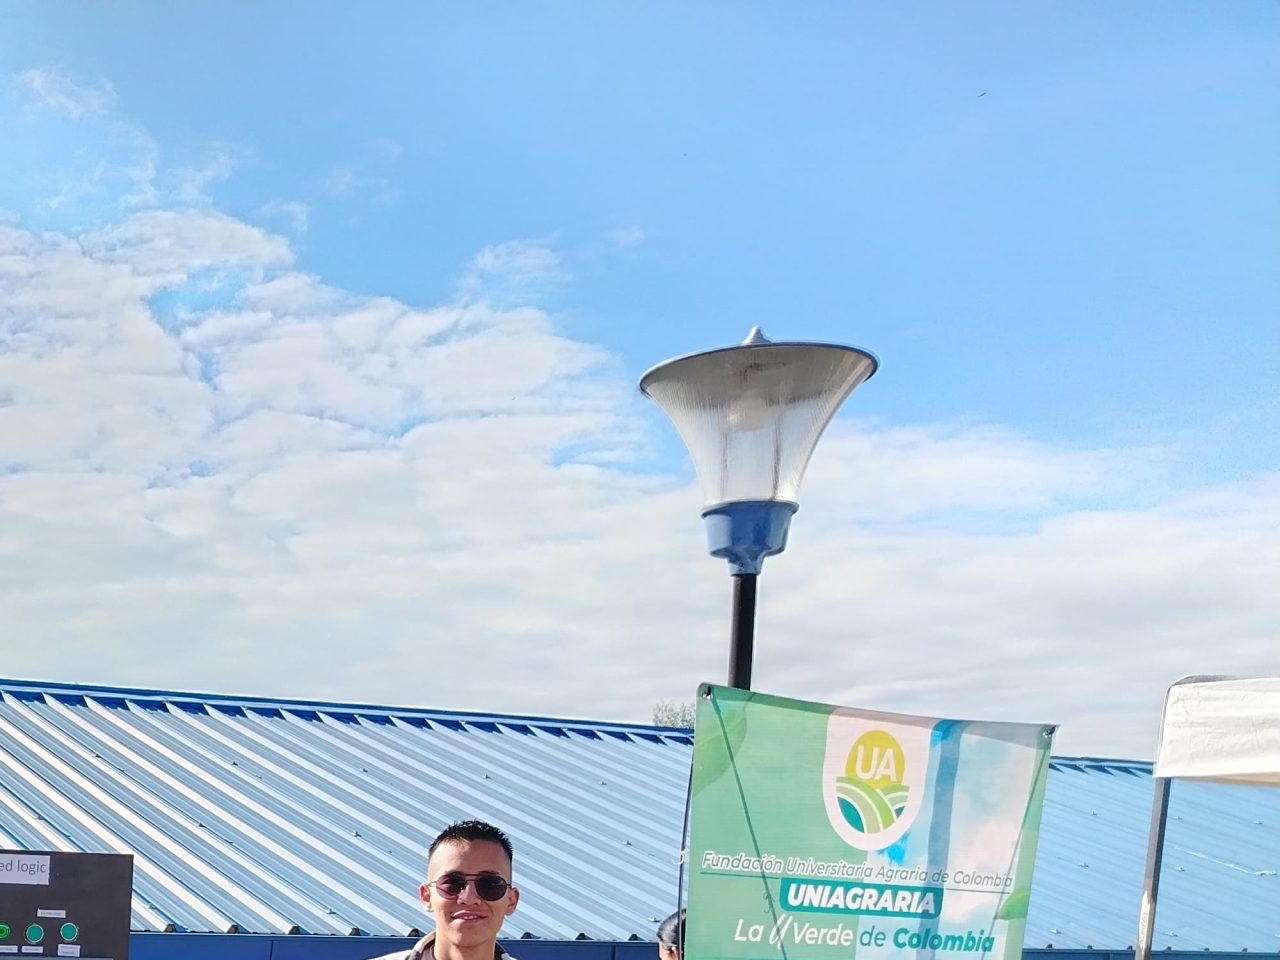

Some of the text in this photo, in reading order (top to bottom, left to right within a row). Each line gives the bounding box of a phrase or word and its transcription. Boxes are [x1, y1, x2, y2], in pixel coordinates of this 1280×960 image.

[855, 745, 897, 782] UA
[17, 860, 47, 876] logic
[701, 851, 1013, 888] Fundación Universitaria Agraria de Colombia
[787, 883, 936, 914] UNIAGRARIA
[734, 920, 764, 942] La
[793, 922, 853, 946] Verde
[860, 925, 886, 947] de
[893, 928, 995, 952] Colombia
